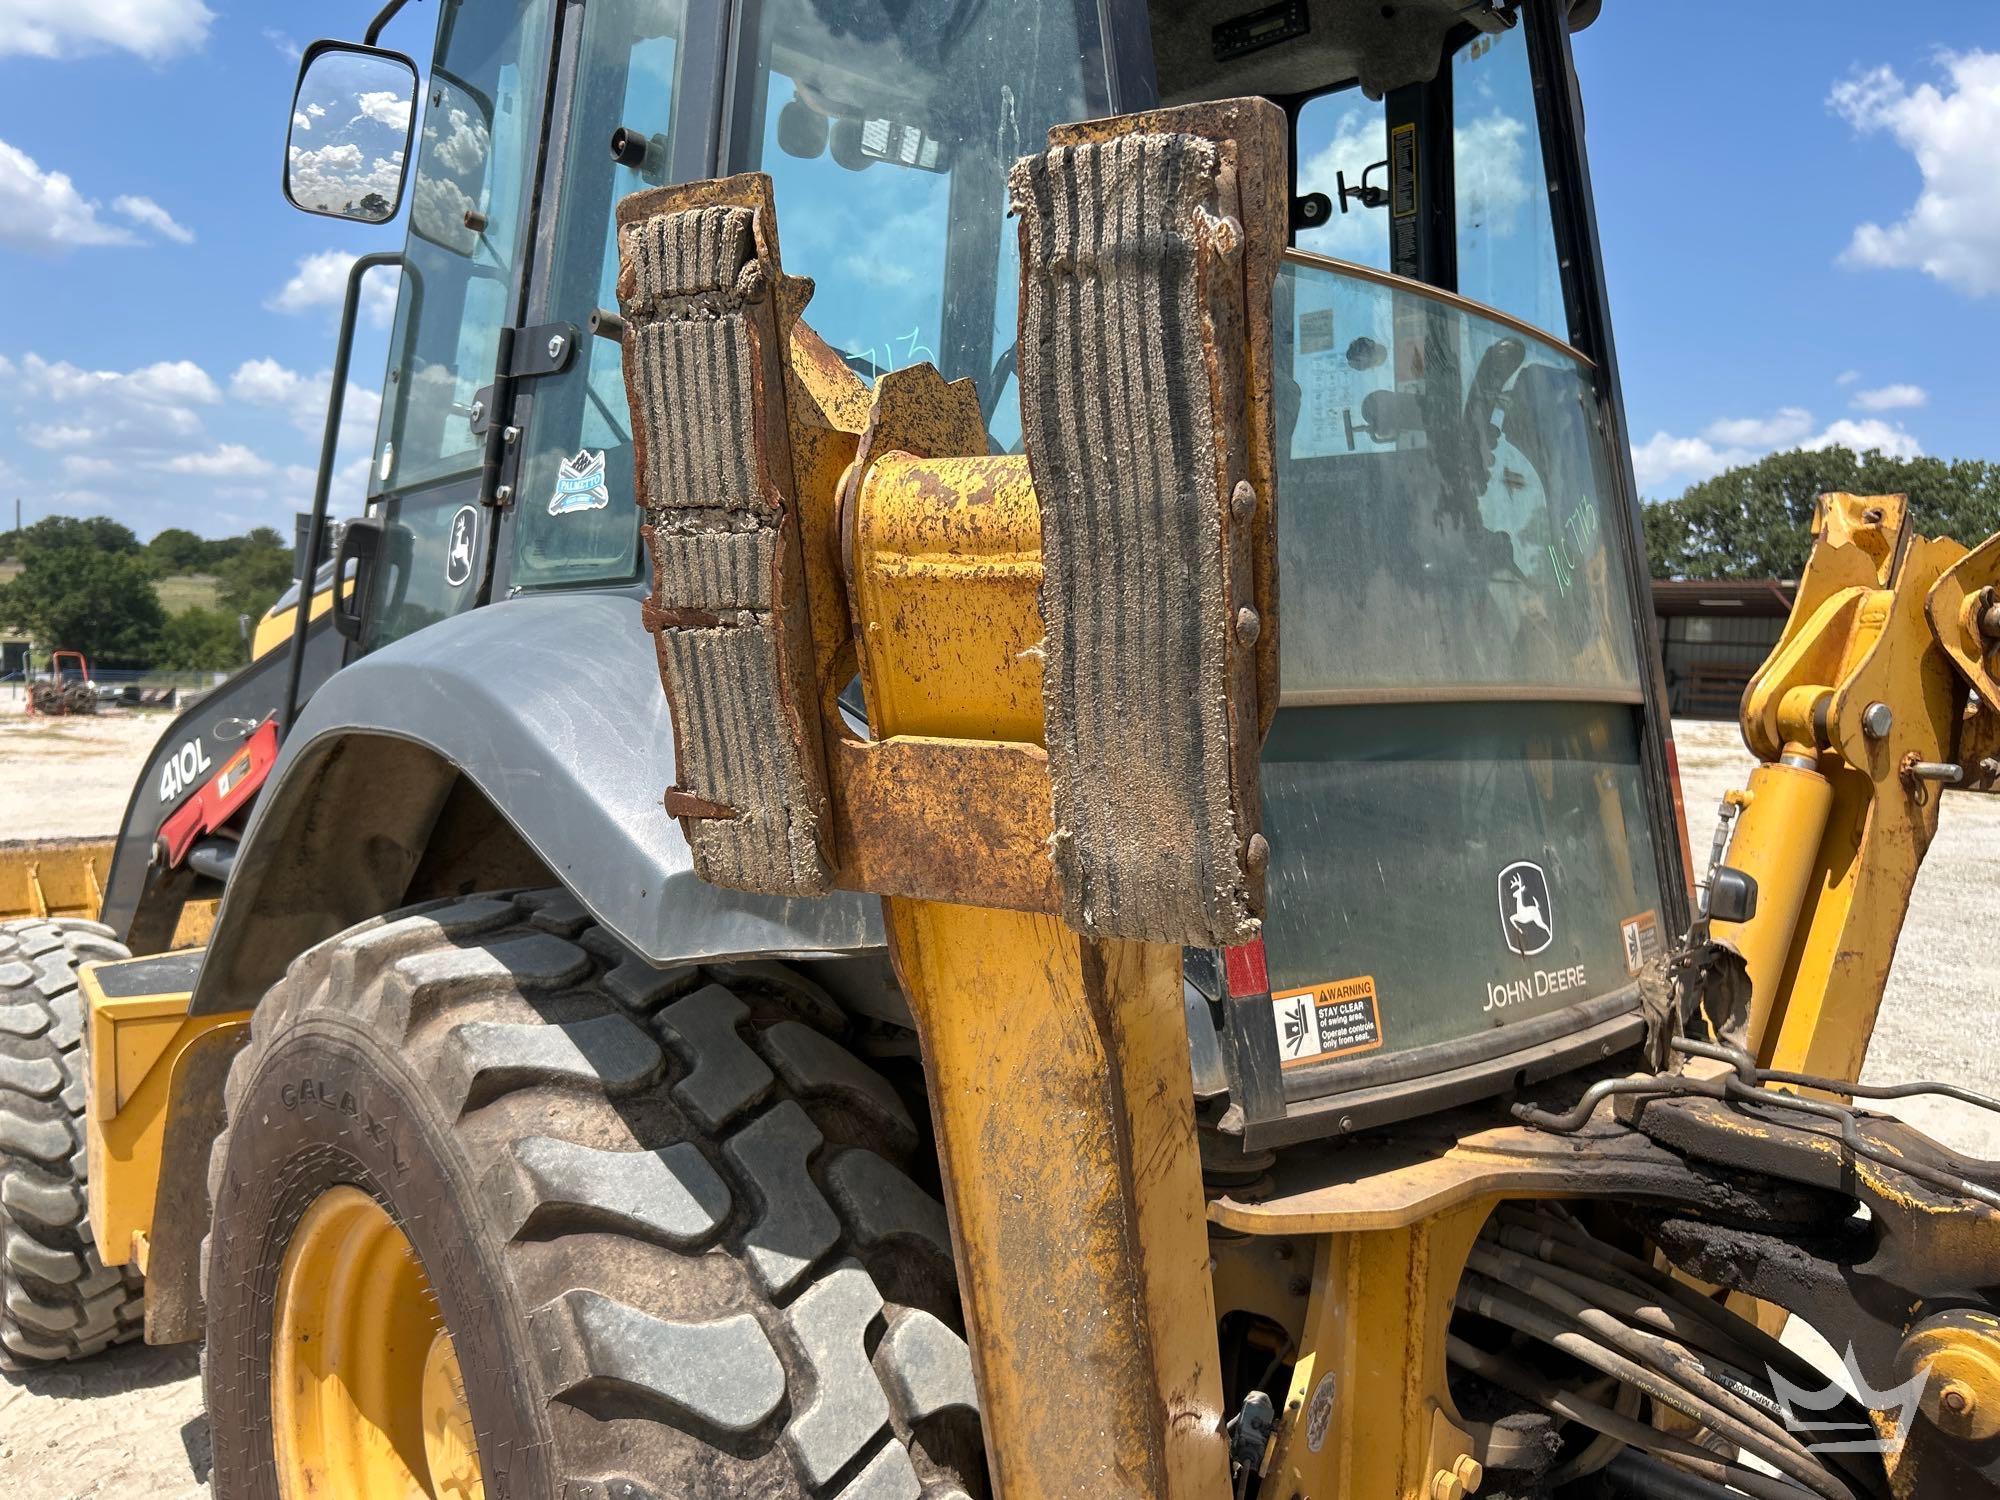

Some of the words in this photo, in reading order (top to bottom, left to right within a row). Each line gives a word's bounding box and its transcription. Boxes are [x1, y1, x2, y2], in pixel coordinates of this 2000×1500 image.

[160, 737, 212, 802] 410L
[1327, 982, 1371, 1000] WARNING
[1483, 978, 1533, 1012] JOHN
[1534, 964, 1586, 997] DEERE
[1319, 1006, 1338, 1018] STAY
[1340, 1001, 1364, 1014] CLEAR
[1320, 1018, 1327, 1027] of
[1328, 1015, 1347, 1026] swing
[1349, 1013, 1364, 1021] area.
[1322, 1028, 1347, 1040] Operate
[1348, 1022, 1374, 1034] controls
[1323, 1040, 1337, 1048] only
[1338, 1036, 1354, 1045] from
[1355, 1032, 1370, 1041] seat.
[281, 1078, 411, 1178] GALAXY
[1751, 1391, 1770, 1406] MPa
[1682, 1404, 1701, 1420] USA
